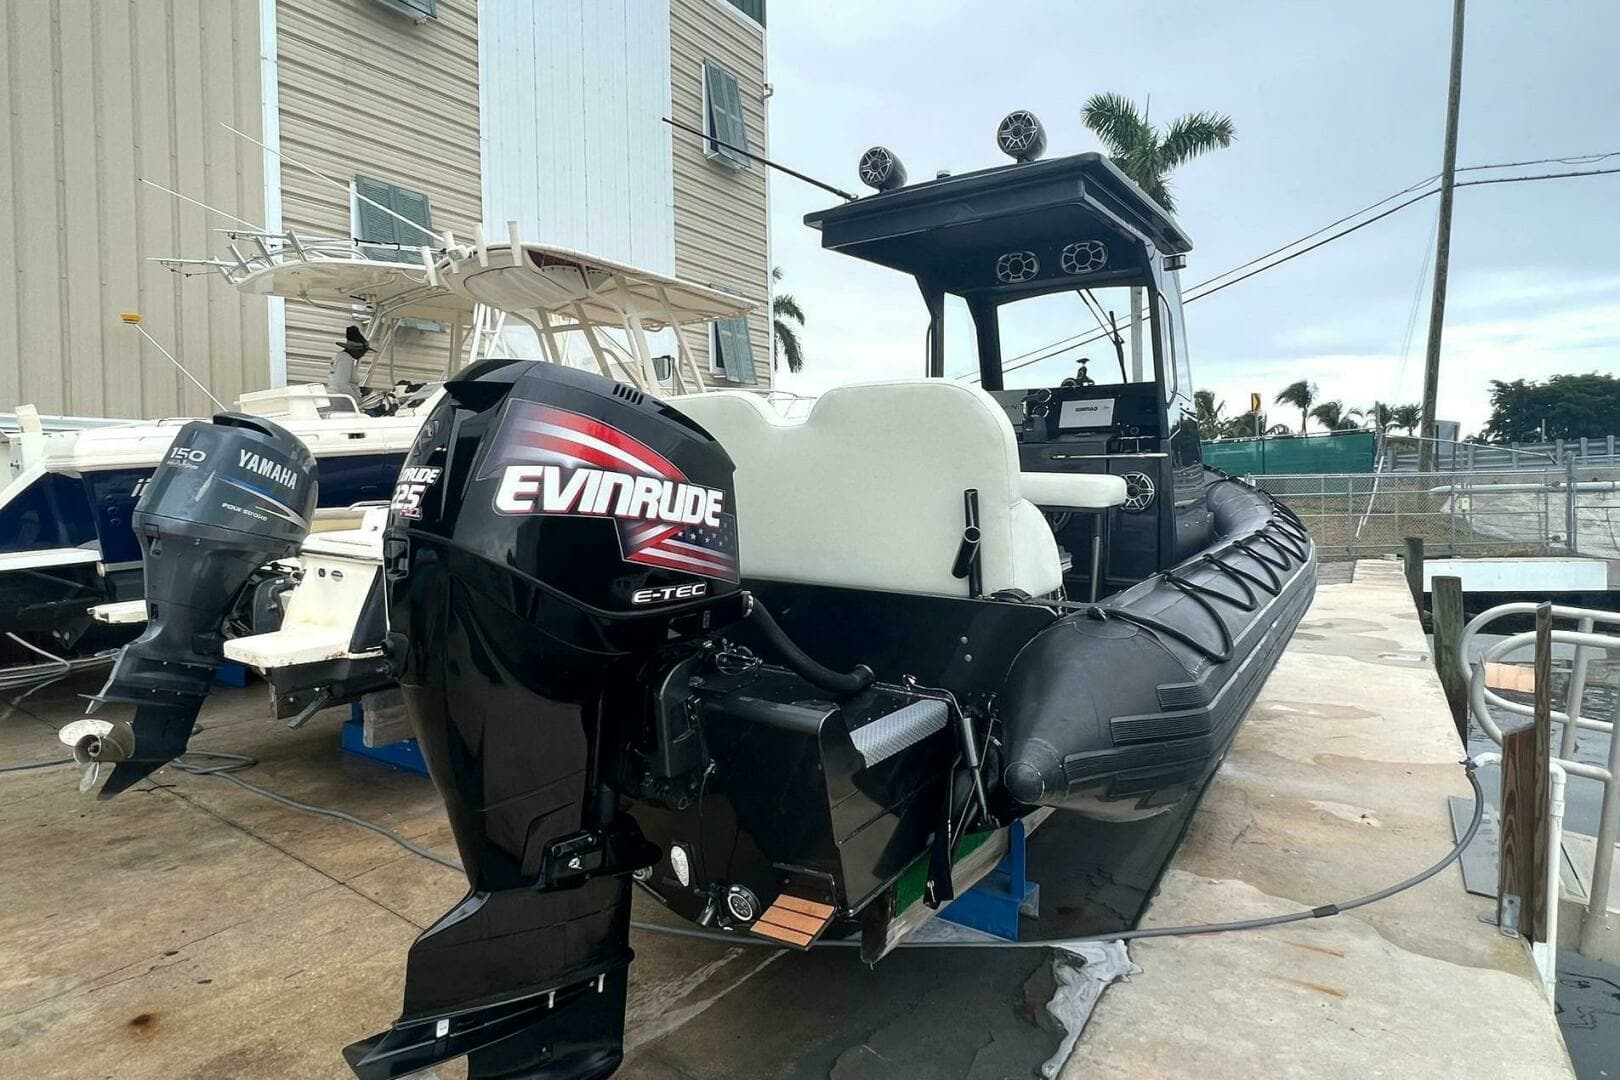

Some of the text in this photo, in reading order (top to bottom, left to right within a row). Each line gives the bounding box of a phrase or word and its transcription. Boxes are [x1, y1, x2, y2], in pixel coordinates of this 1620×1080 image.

[170, 447, 207, 462] 150
[238, 449, 298, 490] YAMAHA
[495, 465, 724, 528] EVINRUDE
[633, 583, 707, 604] E-TEC
